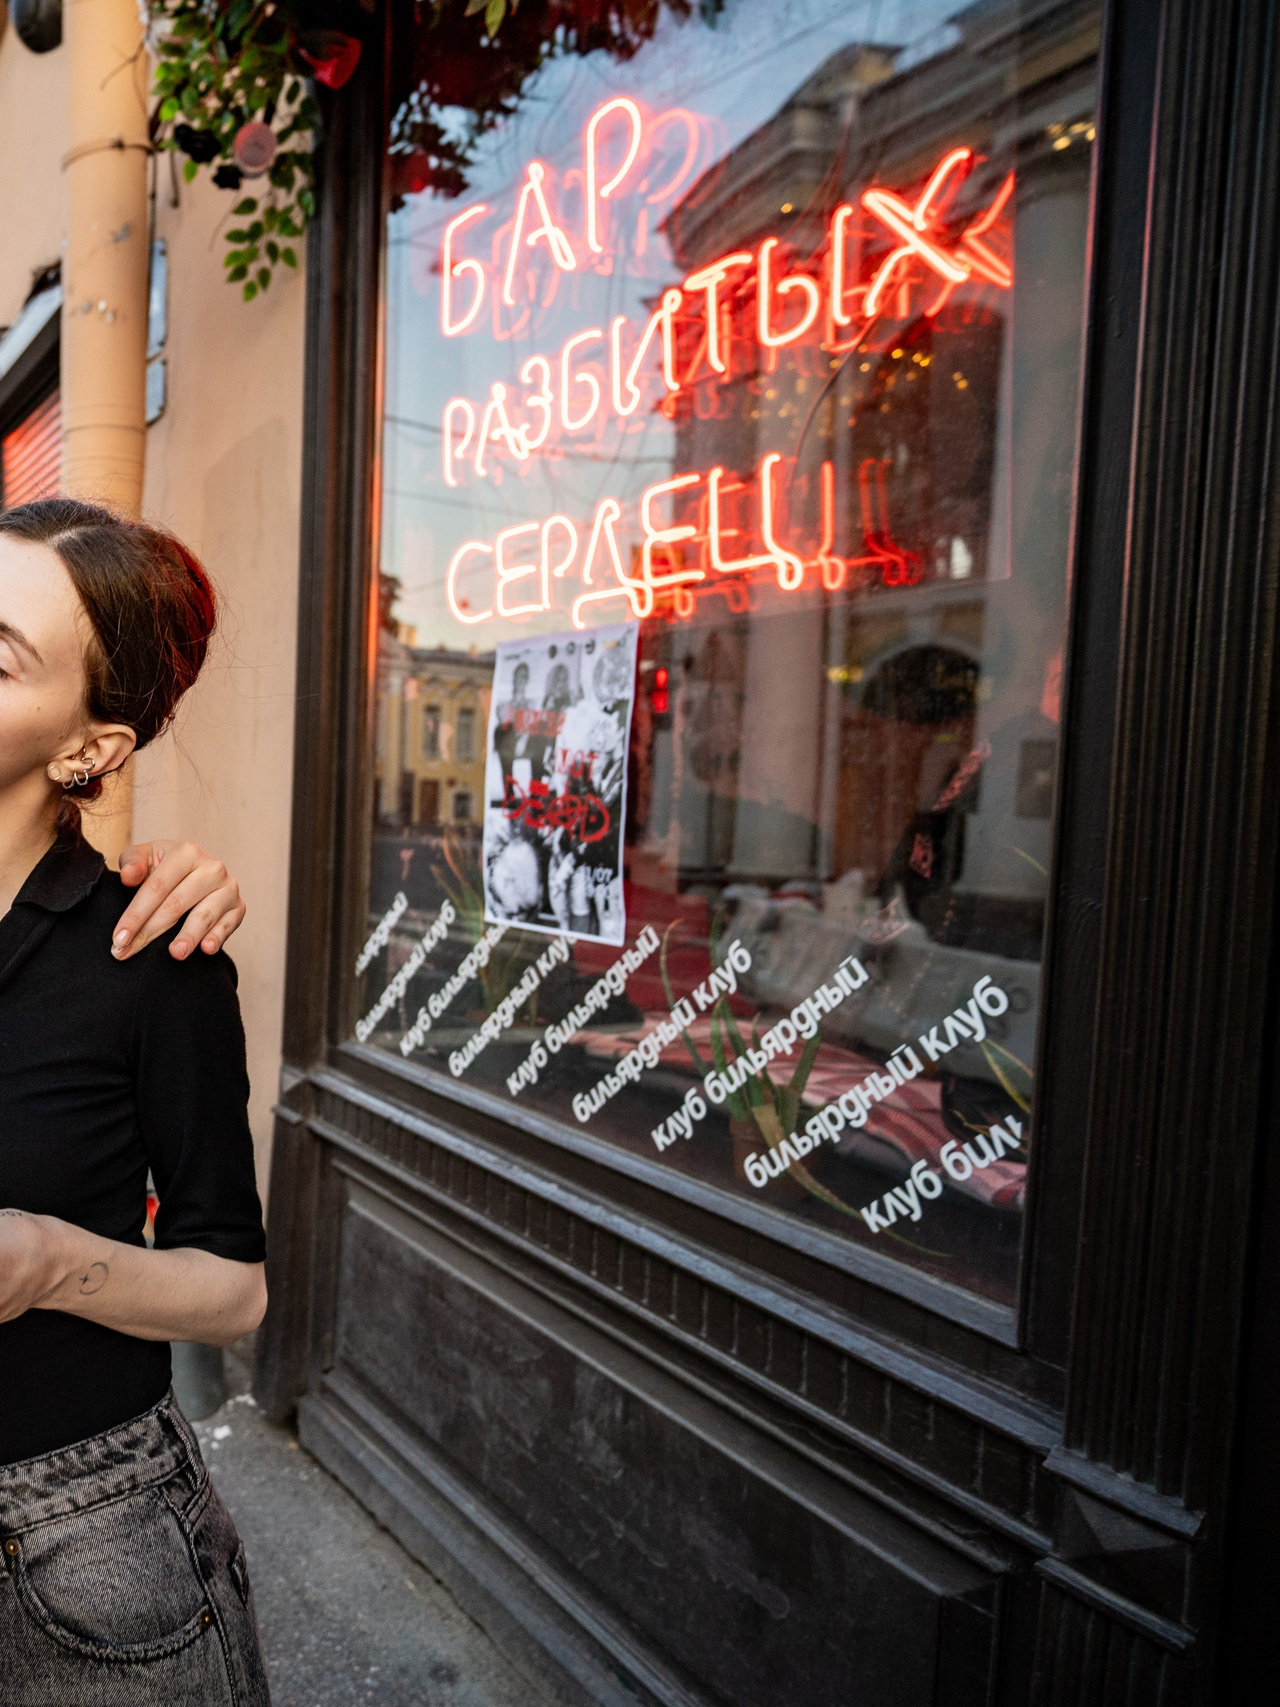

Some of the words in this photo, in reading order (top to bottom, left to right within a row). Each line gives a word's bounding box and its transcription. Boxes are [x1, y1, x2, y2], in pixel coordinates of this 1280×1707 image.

[440, 97, 642, 336] БАР
[442, 146, 974, 487] РАЗБИТЫХ
[447, 453, 805, 629] СЕРДЕЦ
[422, 898, 456, 953] клуб
[506, 1039, 548, 1097] клуб
[544, 924, 661, 1053] бильярдный
[399, 1007, 432, 1057] клуб
[448, 965, 540, 1077] бильярдный
[572, 997, 697, 1122] бильярдный
[692, 939, 752, 1012] клуб
[650, 1087, 707, 1151] клуб
[703, 955, 869, 1104] бильярдный
[743, 1044, 925, 1188] бильярдный
[918, 975, 1009, 1062] клуб
[860, 1159, 943, 1234] клуб
